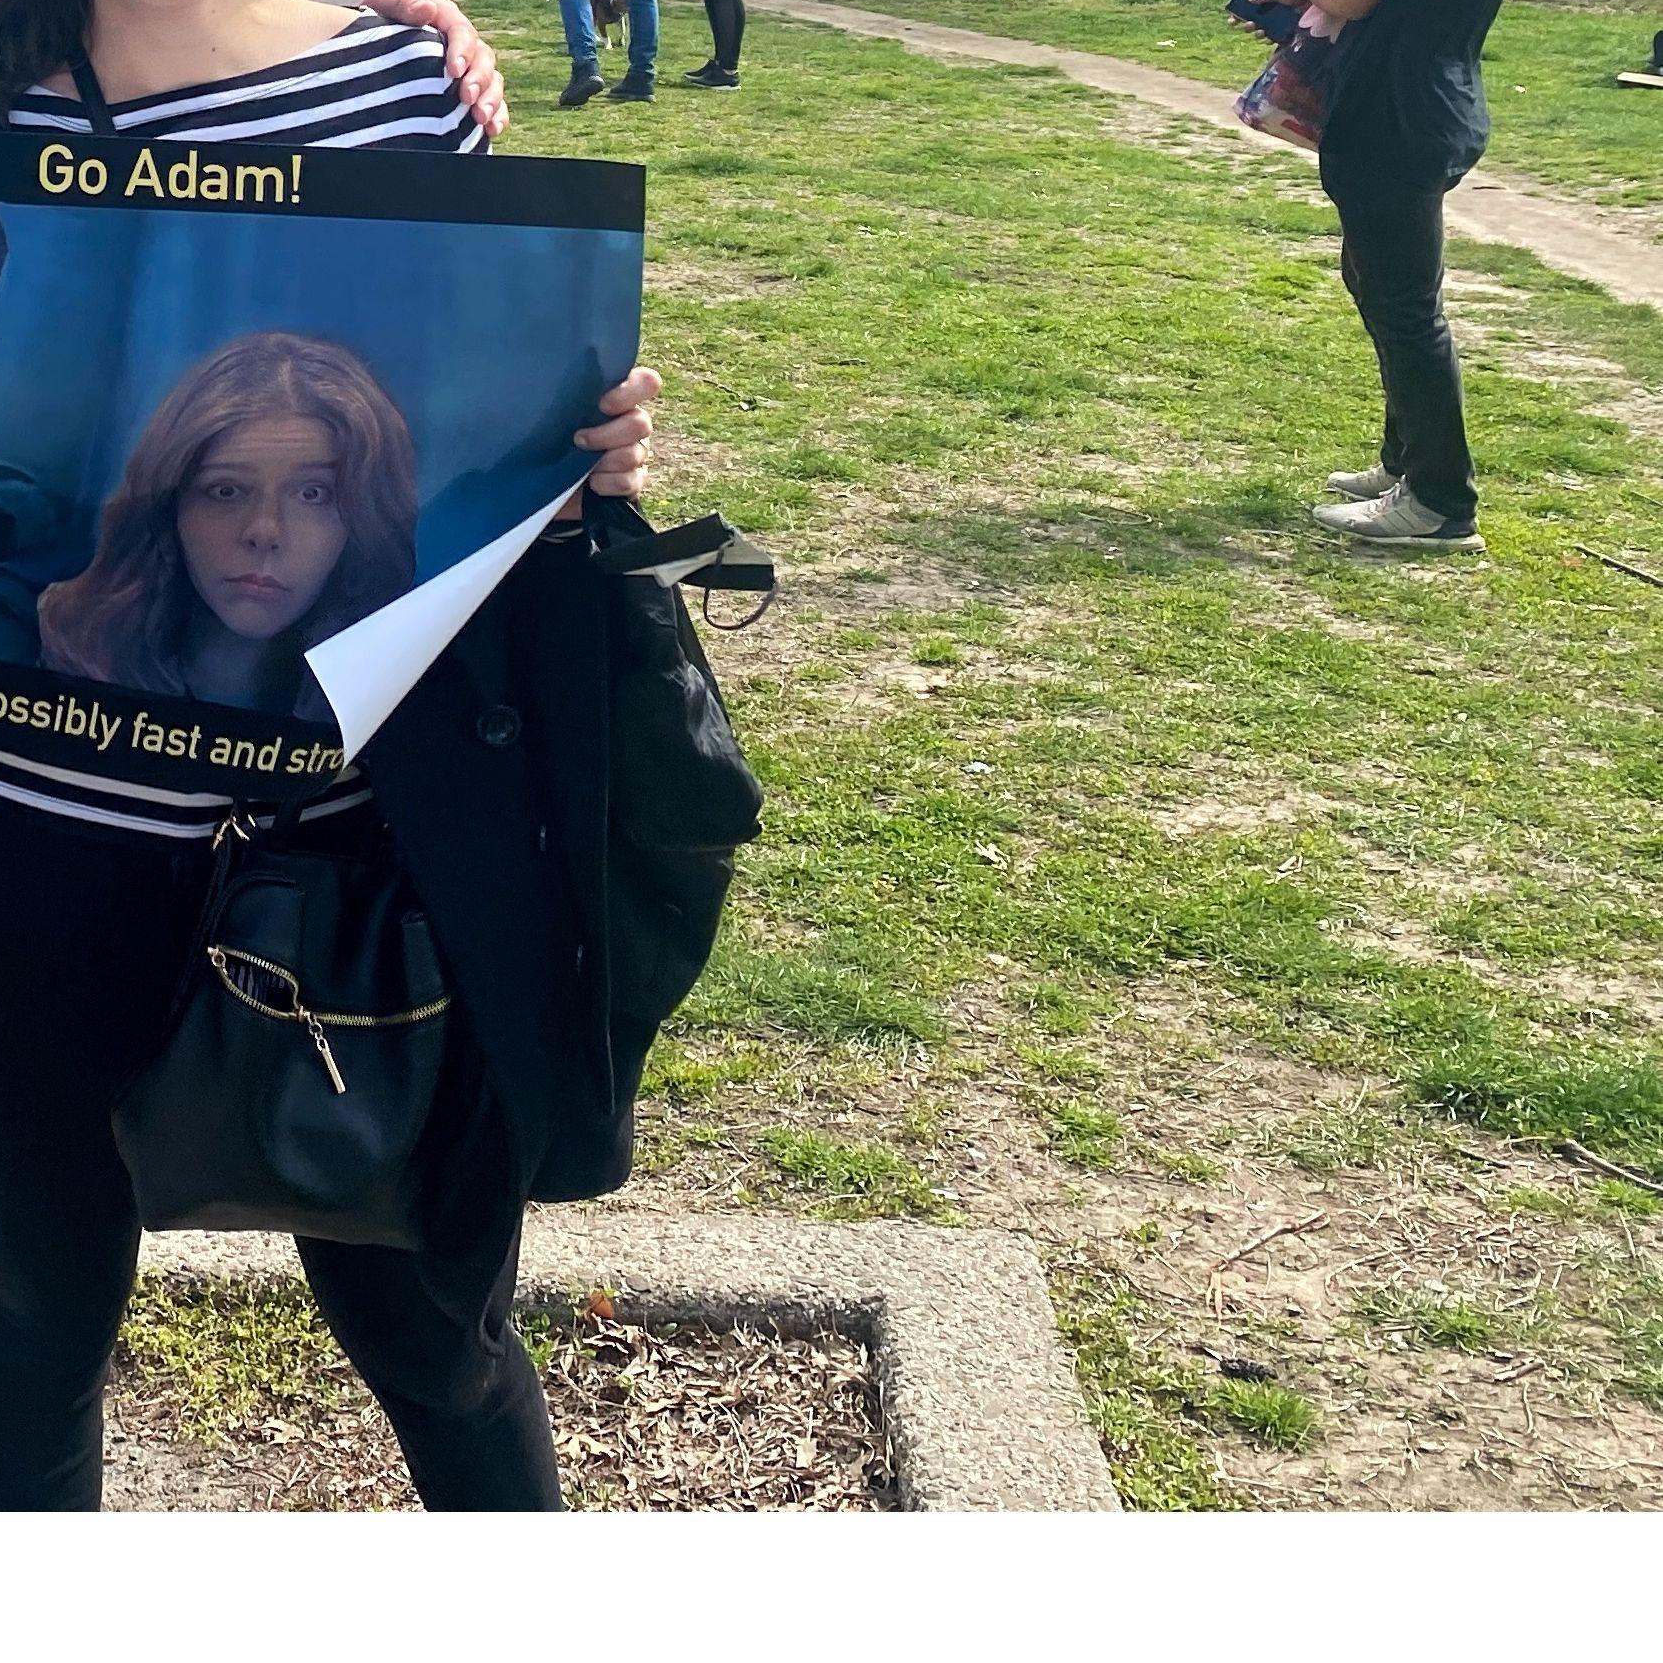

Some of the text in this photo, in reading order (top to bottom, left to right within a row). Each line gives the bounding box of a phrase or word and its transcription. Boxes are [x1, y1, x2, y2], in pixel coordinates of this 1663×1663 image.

[39, 143, 302, 203] Go Adam!
[131, 711, 202, 760] fast
[210, 736, 283, 772] and
